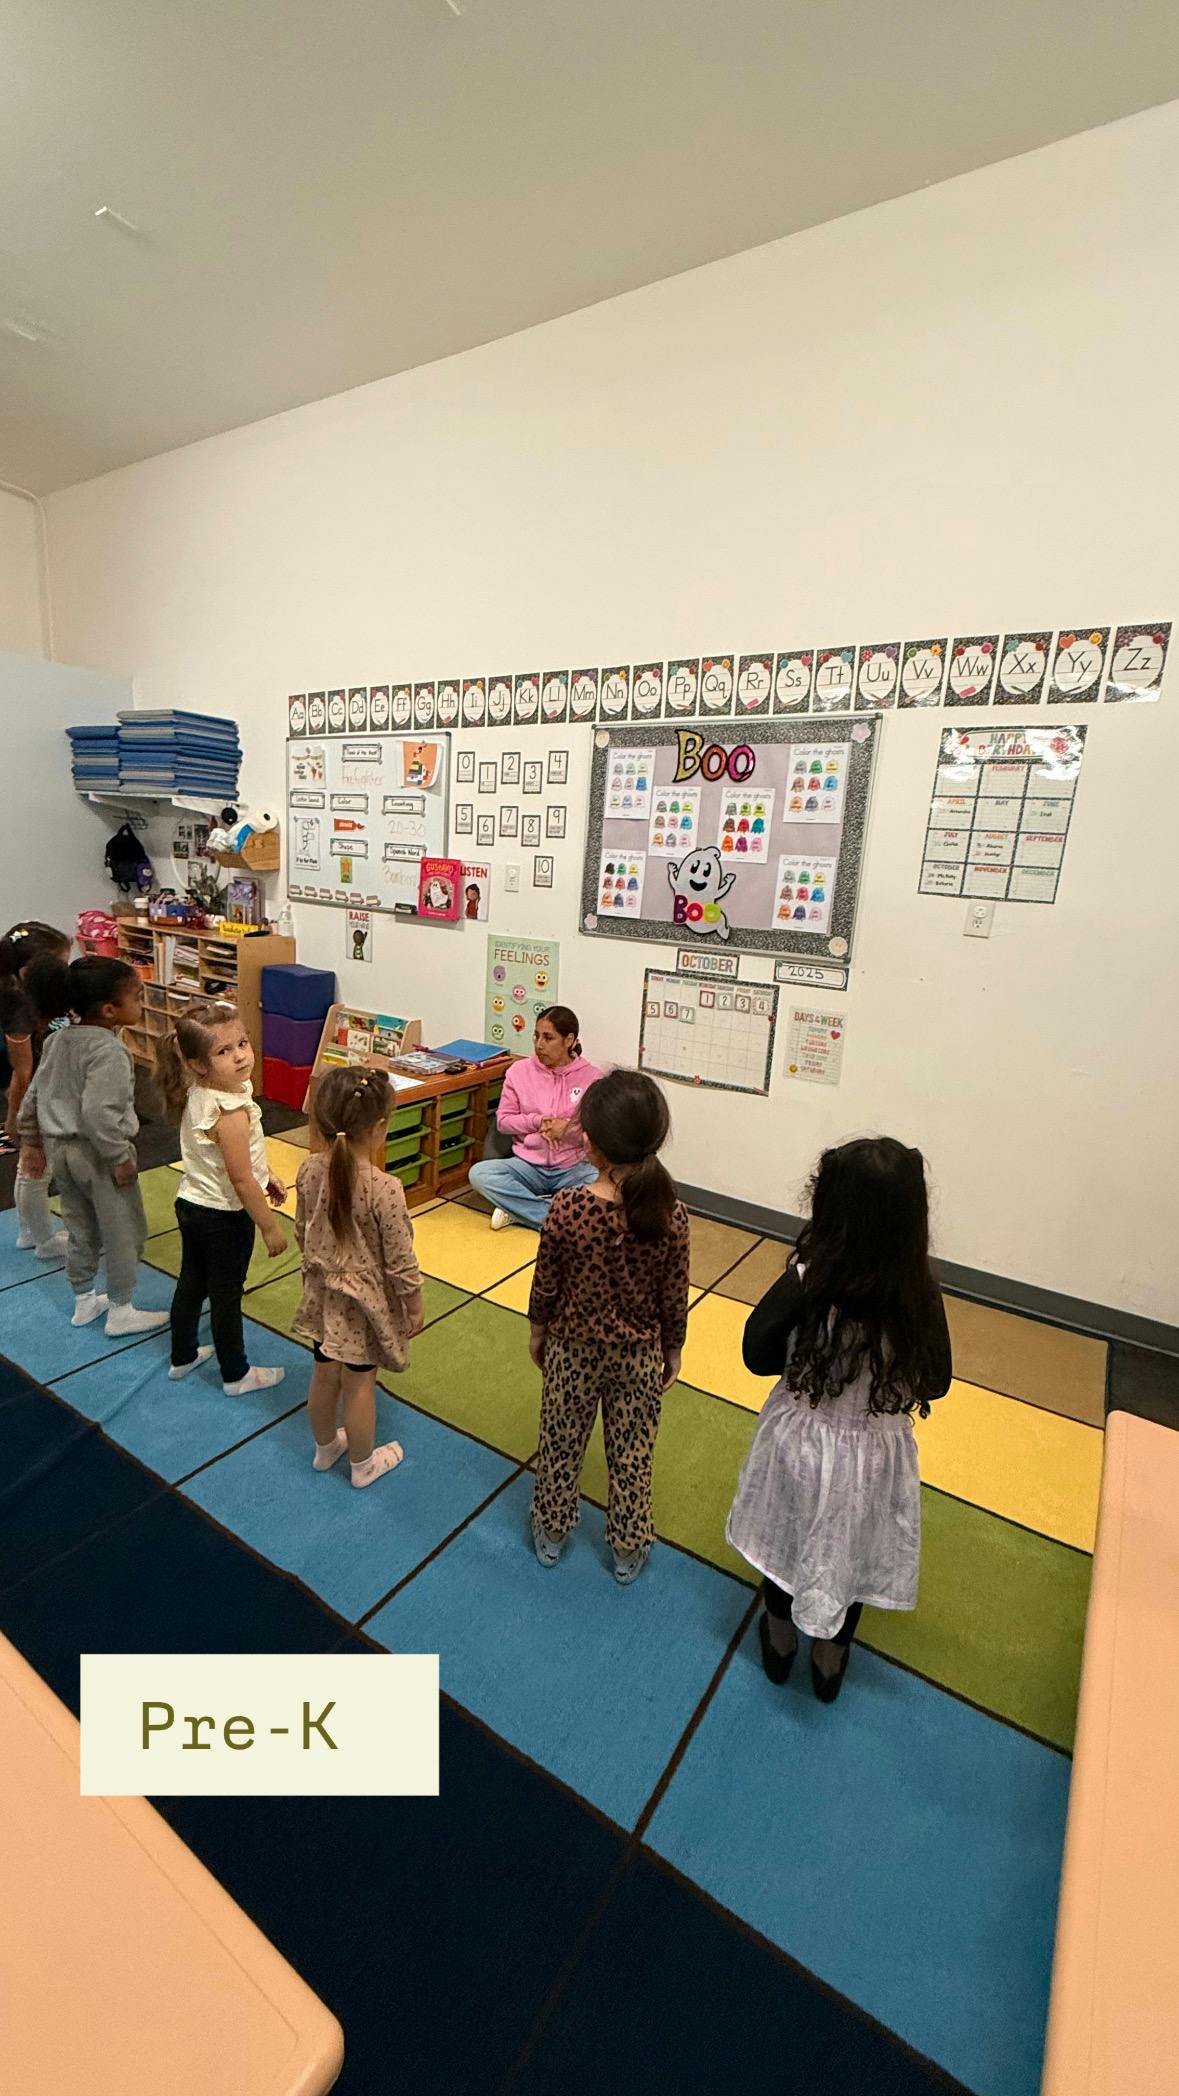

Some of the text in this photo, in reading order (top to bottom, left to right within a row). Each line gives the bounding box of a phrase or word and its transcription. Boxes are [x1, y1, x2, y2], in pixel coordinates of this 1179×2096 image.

[292, 708, 304, 720] Aa
[311, 704, 322, 718] Bb
[331, 703, 343, 716] Cc
[351, 702, 364, 714] Dd
[374, 701, 385, 713] Ee
[396, 698, 407, 712] Ff
[417, 696, 432, 715] Gg
[441, 693, 455, 708] Hh
[493, 690, 505, 712] Jj
[519, 688, 534, 704] Kk
[549, 686, 560, 702] Ll
[573, 686, 595, 701] Mm
[606, 683, 624, 699] Nn
[638, 680, 657, 697] Oo
[674, 677, 691, 700] Pp
[705, 674, 727, 699] Qq
[746, 672, 764, 690] Rr
[784, 669, 802, 688] Ss
[825, 666, 844, 685] Tt
[867, 663, 890, 682] Uu
[912, 659, 934, 680] Vv
[957, 656, 989, 677] Ww
[1008, 653, 1036, 674] Xx
[1068, 651, 1092, 683] Yy
[1123, 647, 1152, 671] Zz
[462, 755, 471, 769] 0
[507, 755, 515, 770] 2
[554, 754, 562, 768] 4
[529, 764, 537, 780] 3
[460, 807, 468, 821] 5
[506, 809, 513, 823] 7
[553, 809, 560, 824] 9
[482, 818, 489, 832] 6
[527, 818, 535, 833] 8
[460, 866, 488, 878] LISTEN
[537, 859, 550, 873] 10
[349, 911, 369, 922] RAISE
[494, 948, 550, 966] FEELINGS
[682, 955, 733, 973] OCTOBER
[788, 966, 825, 980] 2025
[722, 995, 728, 1006] 2
[740, 998, 746, 1009] 3
[758, 1000, 765, 1011] 4
[650, 1004, 690, 1019] 5 6 7
[794, 1012, 814, 1023] DAYS
[821, 1015, 844, 1028] WEEK
